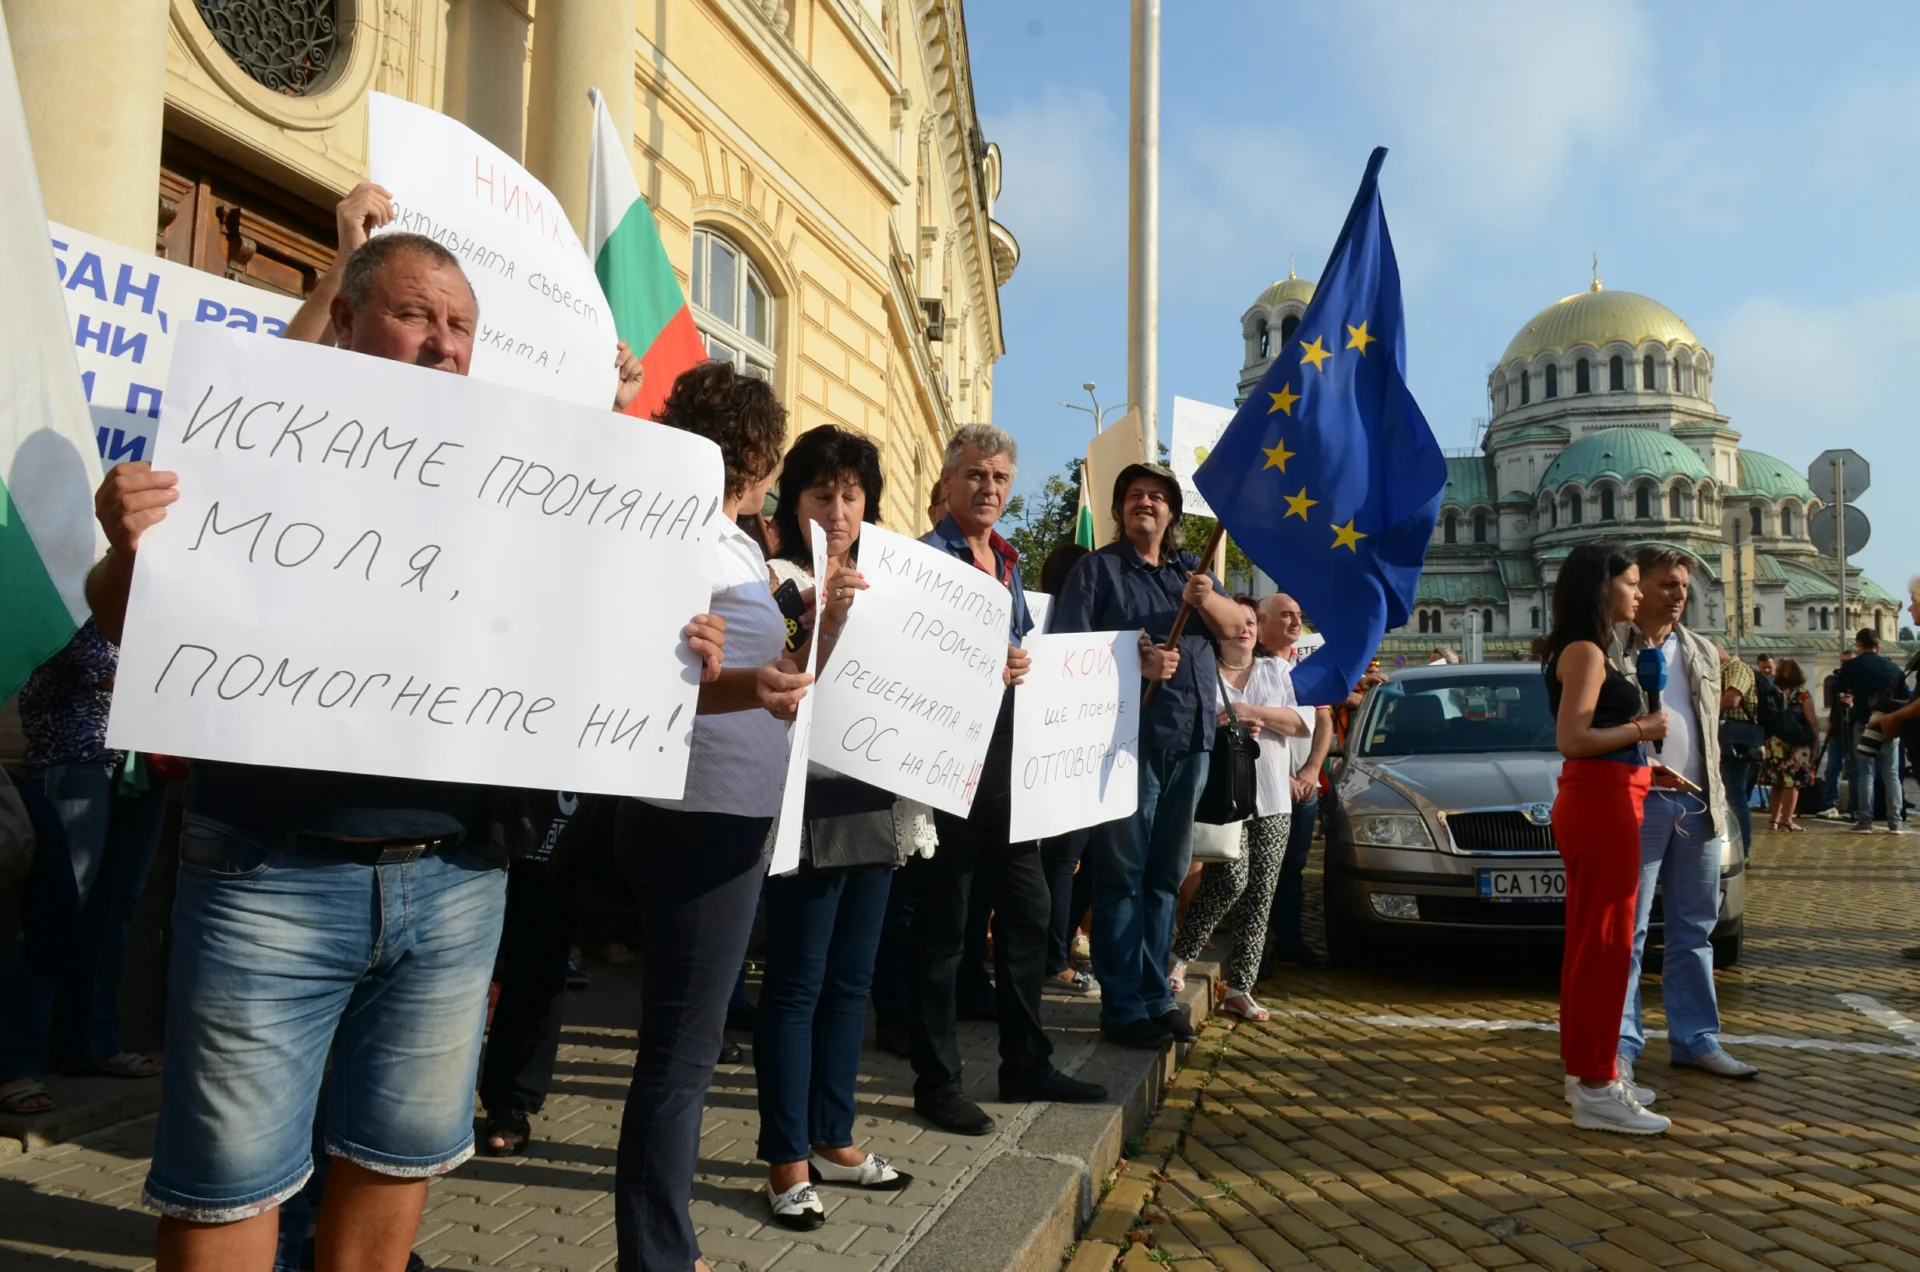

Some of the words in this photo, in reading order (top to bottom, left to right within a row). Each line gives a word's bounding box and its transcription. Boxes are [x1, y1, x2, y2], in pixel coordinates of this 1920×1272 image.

[181, 384, 464, 488] ИСКАМЕ
[477, 454, 720, 542] ПРОМЯНА!
[188, 501, 460, 601] МОЛЯ,
[1062, 640, 1115, 678] КОЙ
[1294, 646, 1317, 656] ЕТЕ
[577, 702, 684, 753] НИ!
[964, 718, 983, 742] НА
[1044, 706, 1068, 728] ЩЕ
[841, 716, 899, 763] ОС
[899, 752, 924, 777] НА
[1494, 874, 1522, 894] CA
[1529, 874, 1566, 894] 190
